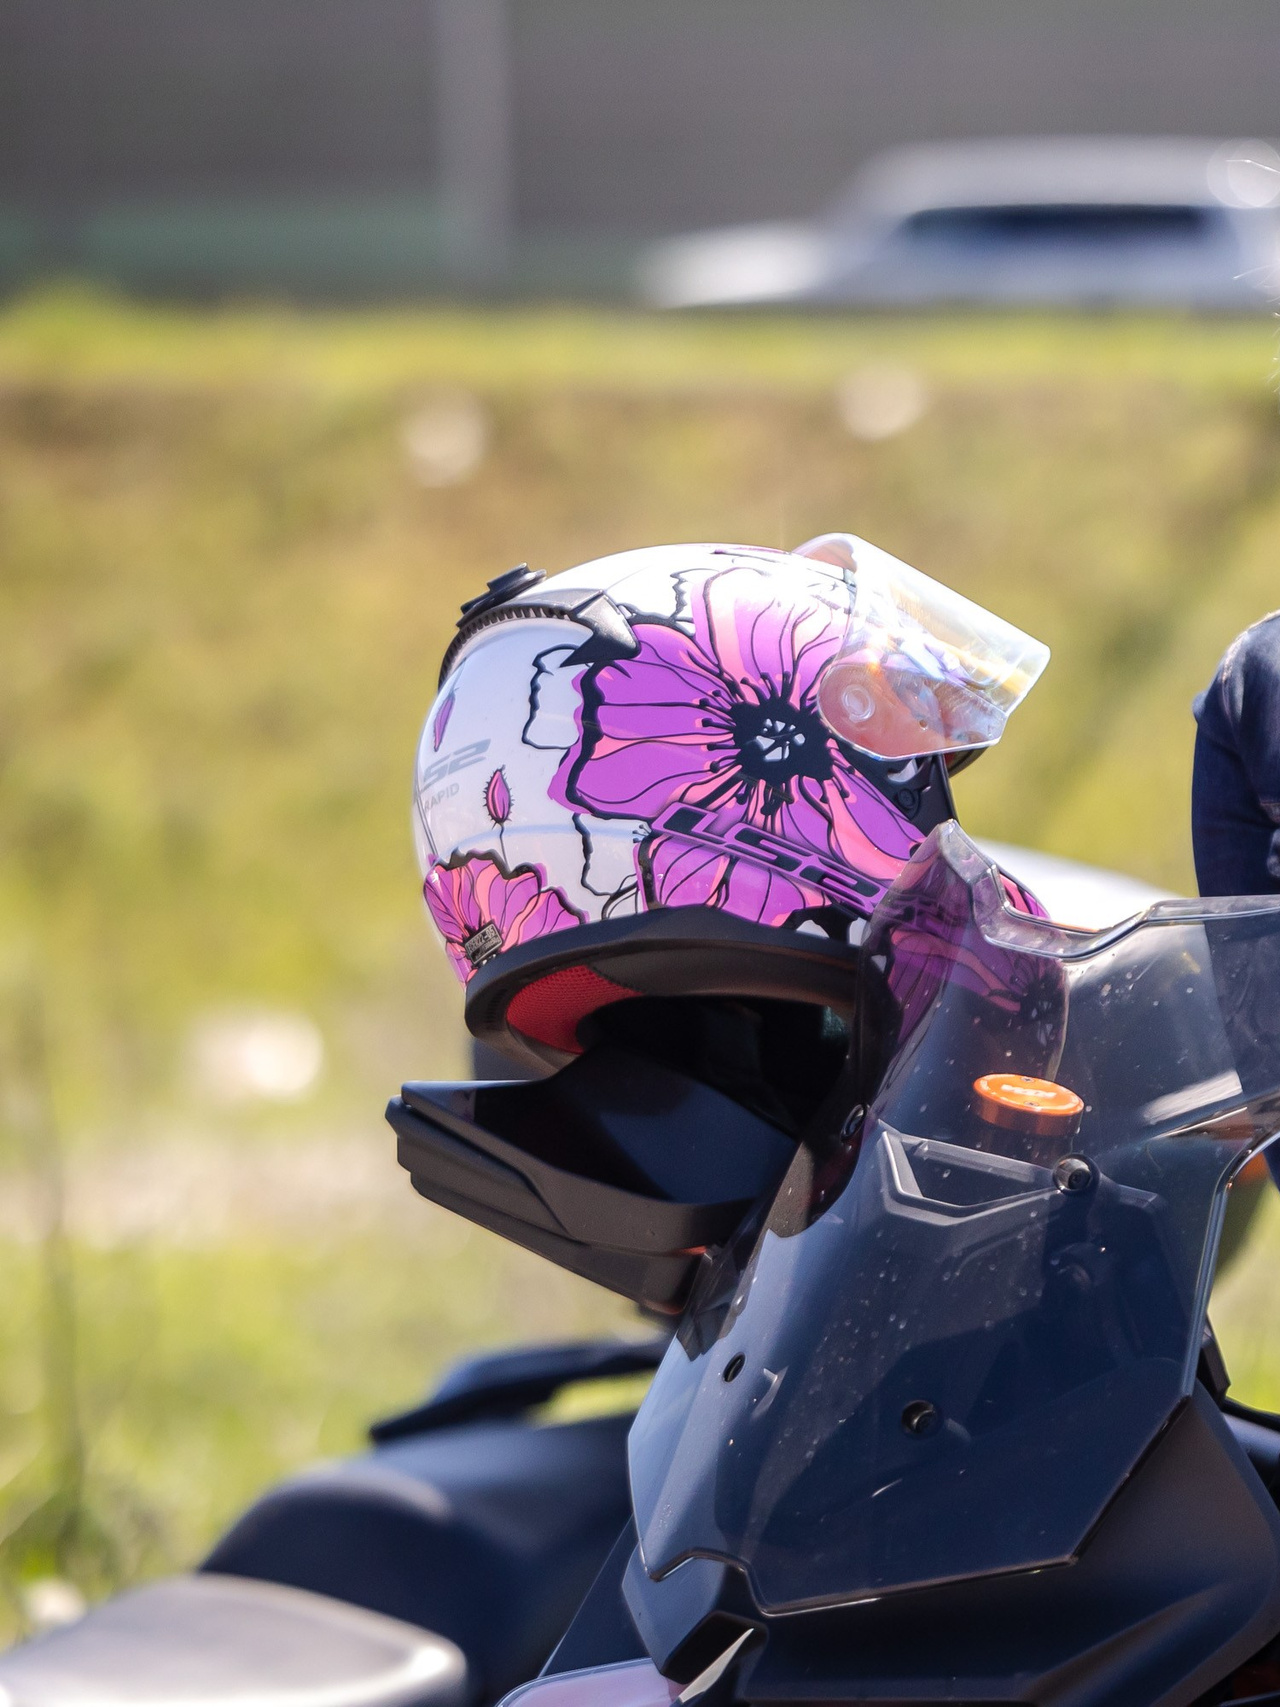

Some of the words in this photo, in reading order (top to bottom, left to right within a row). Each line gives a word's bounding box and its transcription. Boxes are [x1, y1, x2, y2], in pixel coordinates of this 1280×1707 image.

[418, 738, 492, 795] S2
[424, 782, 460, 812] RAPID
[660, 803, 885, 909] LS2
